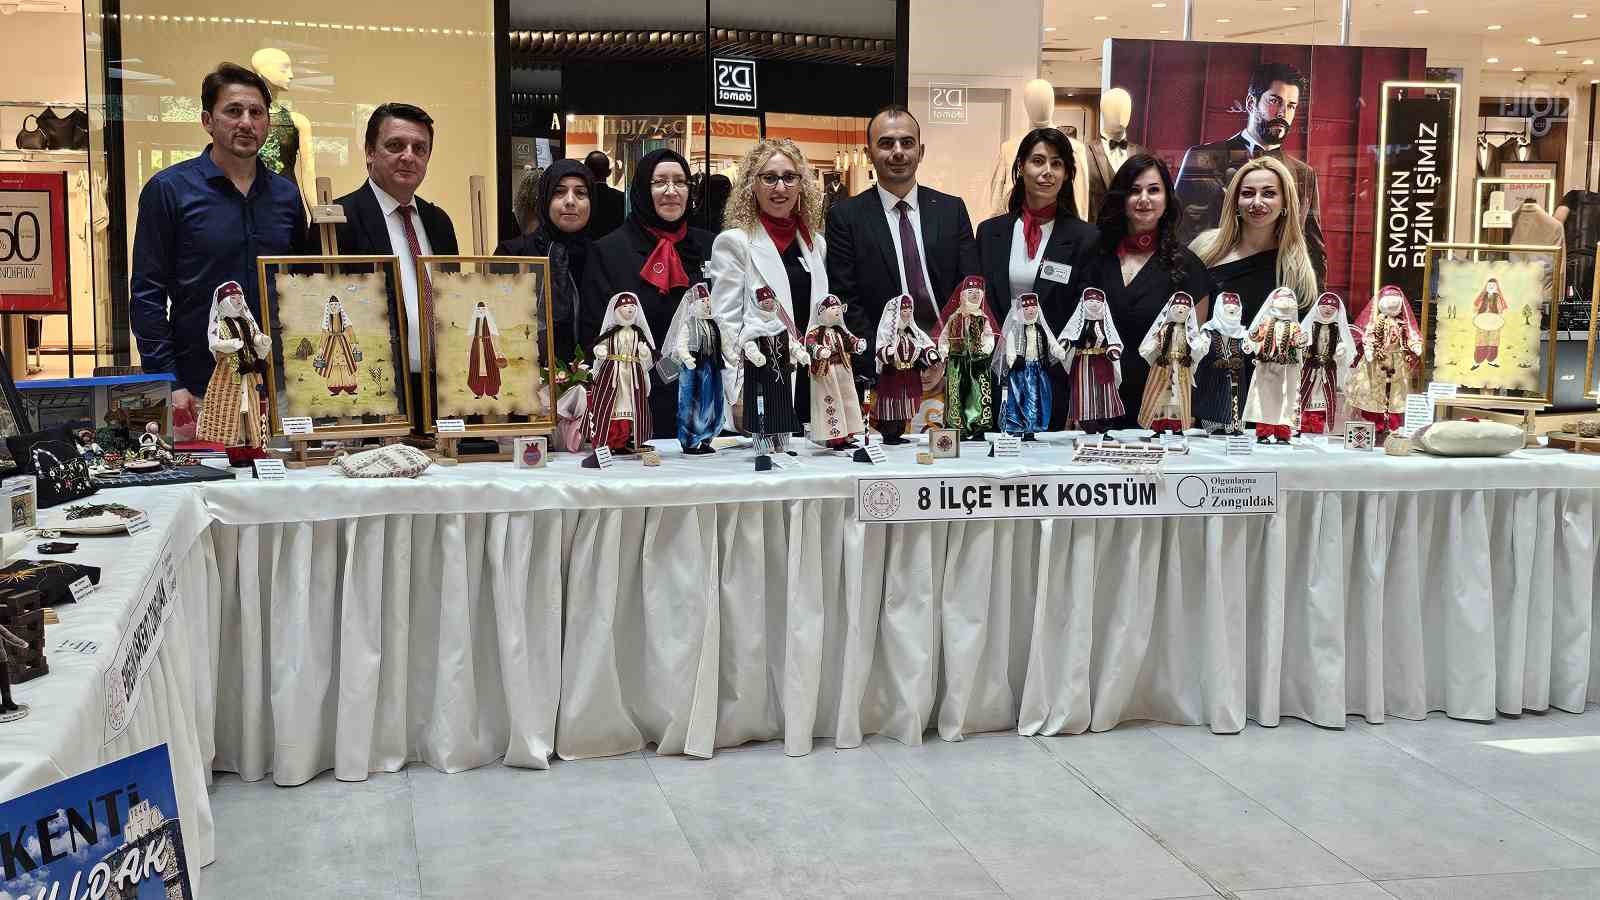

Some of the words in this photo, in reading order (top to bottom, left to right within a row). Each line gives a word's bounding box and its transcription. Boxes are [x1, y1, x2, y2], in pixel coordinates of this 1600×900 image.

[1412, 122, 1441, 194] İŞİMİZ
[1386, 171, 1410, 269] SMOKİN
[1410, 202, 1434, 268] BİZİM
[917, 487, 931, 509] 8
[939, 481, 992, 515] İLÇE
[1000, 483, 1049, 508] TEK
[1057, 478, 1157, 507] KOSTÜM
[1211, 496, 1274, 510] Zonguldak
